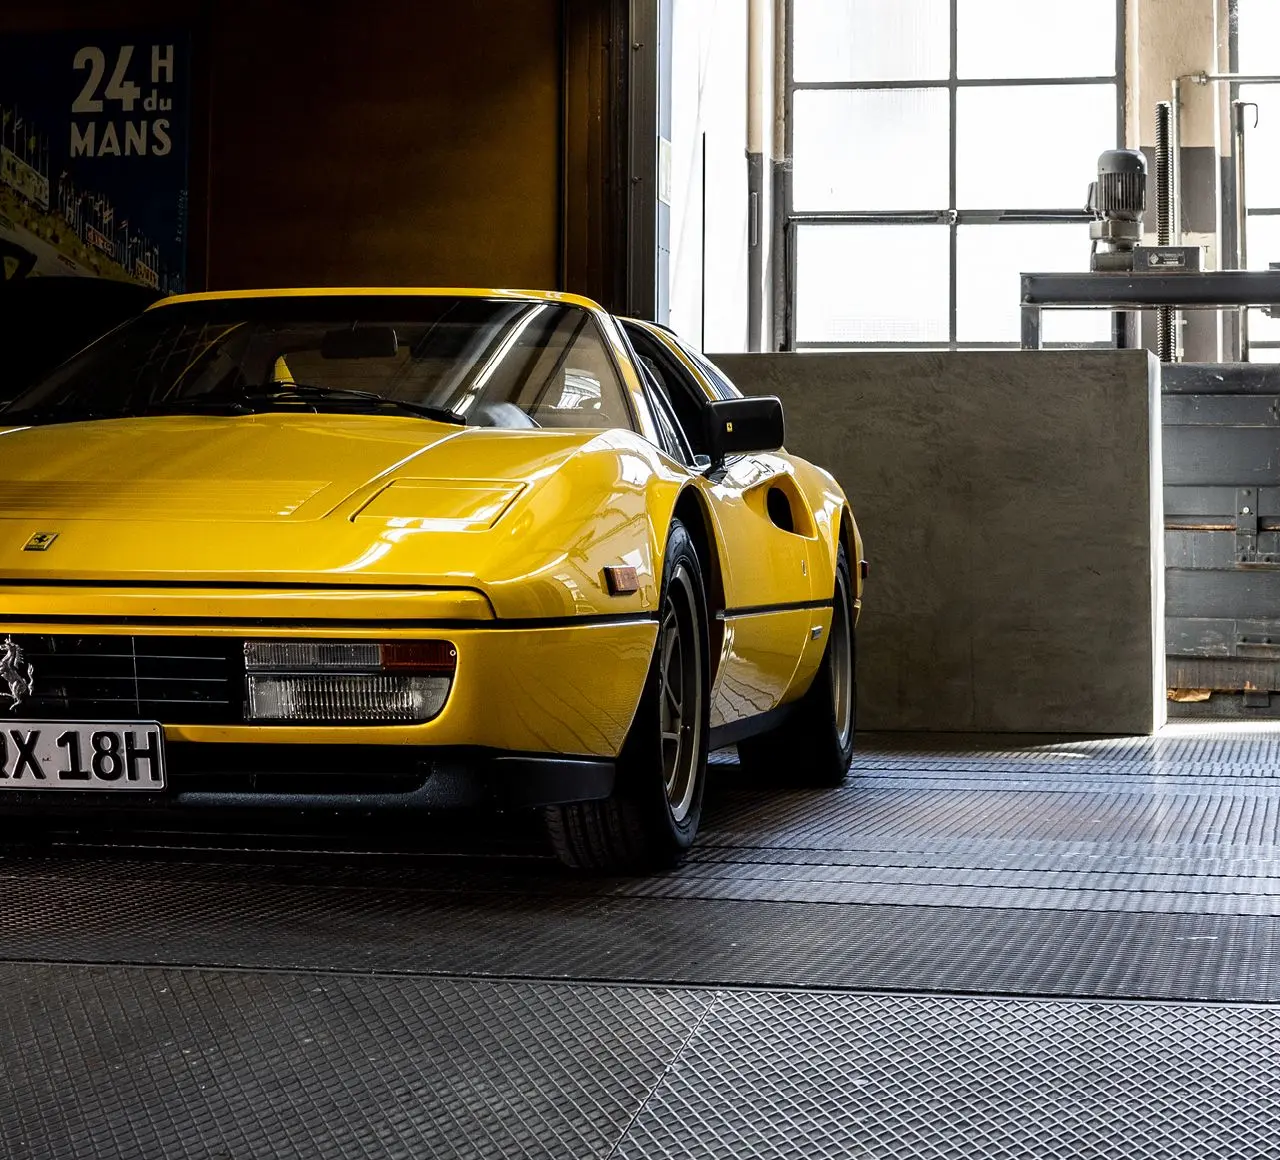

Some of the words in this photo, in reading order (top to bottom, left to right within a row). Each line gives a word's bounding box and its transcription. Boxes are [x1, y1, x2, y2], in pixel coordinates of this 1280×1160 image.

[71, 45, 141, 113] 24
[151, 45, 174, 84] H
[143, 89, 172, 112] du
[69, 118, 173, 158] MANS
[55, 730, 163, 782] 18H
